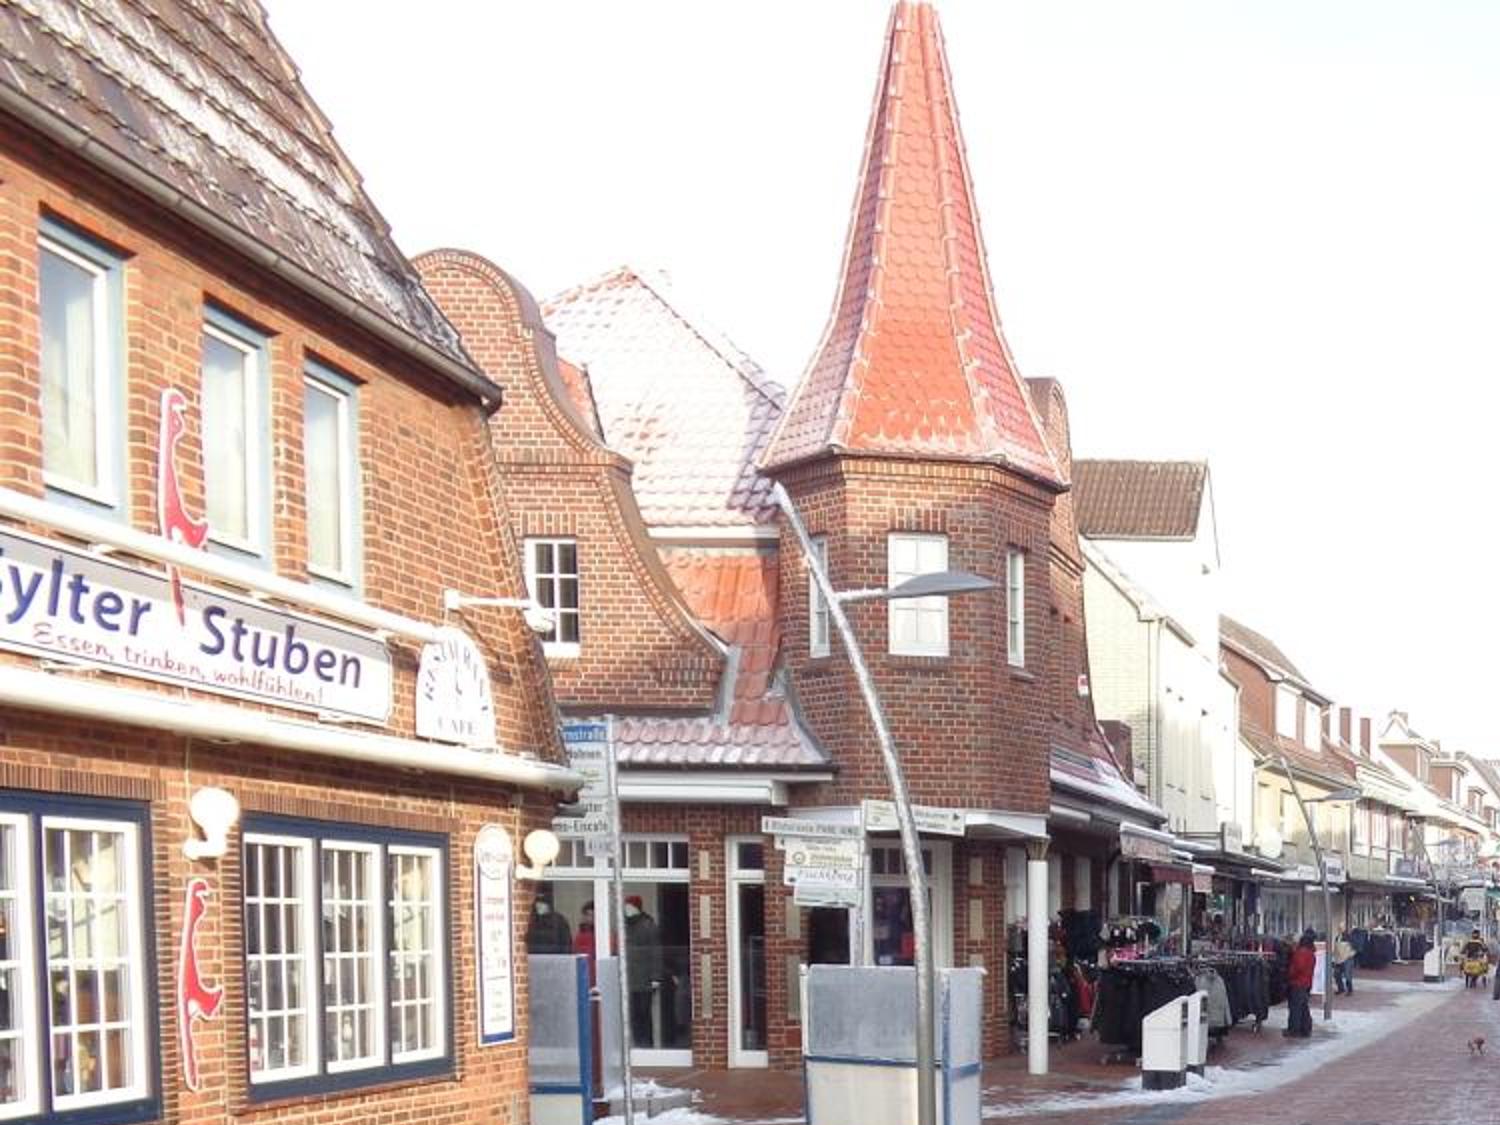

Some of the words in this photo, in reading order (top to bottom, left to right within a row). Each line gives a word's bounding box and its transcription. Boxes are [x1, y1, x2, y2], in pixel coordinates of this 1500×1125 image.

[0, 547, 152, 636] ylter
[200, 605, 361, 689] Stuben
[33, 621, 114, 661] Essen,
[124, 645, 206, 680] trinken,
[214, 665, 324, 704] wohlfühlen!
